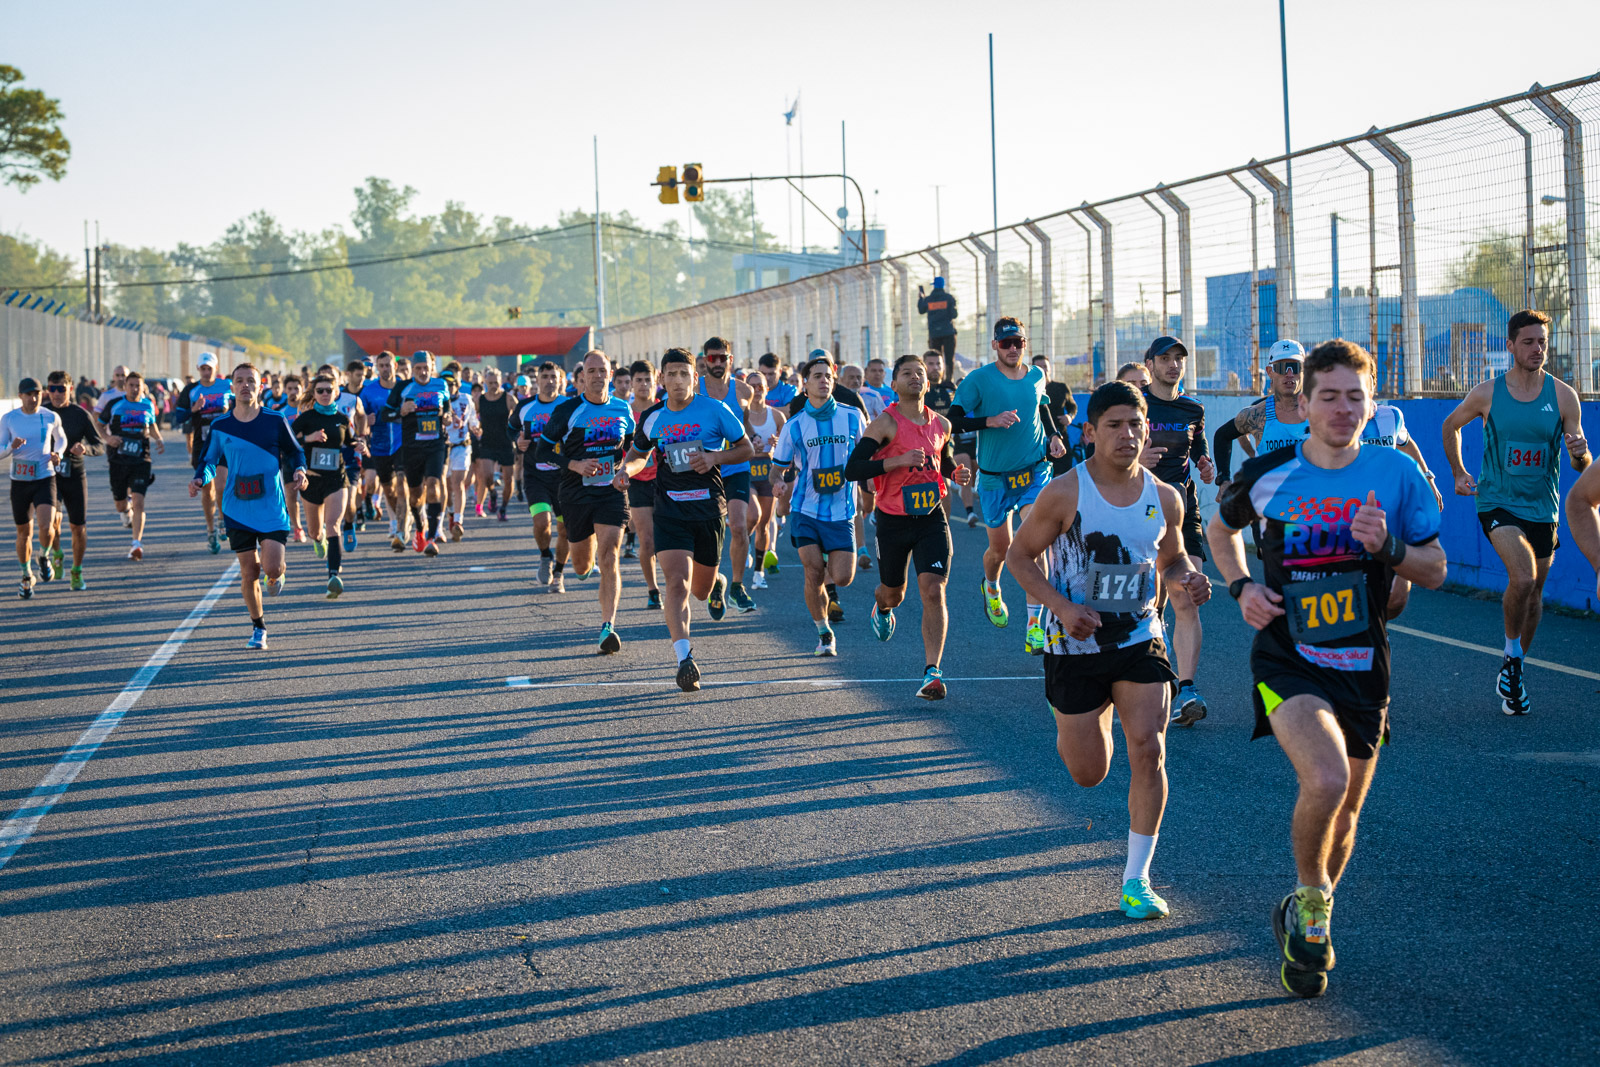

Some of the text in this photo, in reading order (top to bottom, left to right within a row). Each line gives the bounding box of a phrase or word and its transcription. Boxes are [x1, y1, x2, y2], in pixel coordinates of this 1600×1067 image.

[421, 420, 437, 432] 797
[1149, 422, 1190, 432] UNNEA
[122, 441, 138, 453] 140
[806, 434, 846, 448] GUEPARD
[319, 453, 331, 465] 21
[1511, 449, 1542, 467] 344
[16, 463, 35, 476] 374
[750, 464, 768, 476] 616
[818, 471, 841, 488] 705
[1008, 471, 1031, 489] 747
[239, 480, 261, 495] 312
[911, 490, 936, 509] 712
[1099, 574, 1140, 600] 174
[1300, 588, 1355, 629] 707
[1309, 927, 1323, 936] 707
